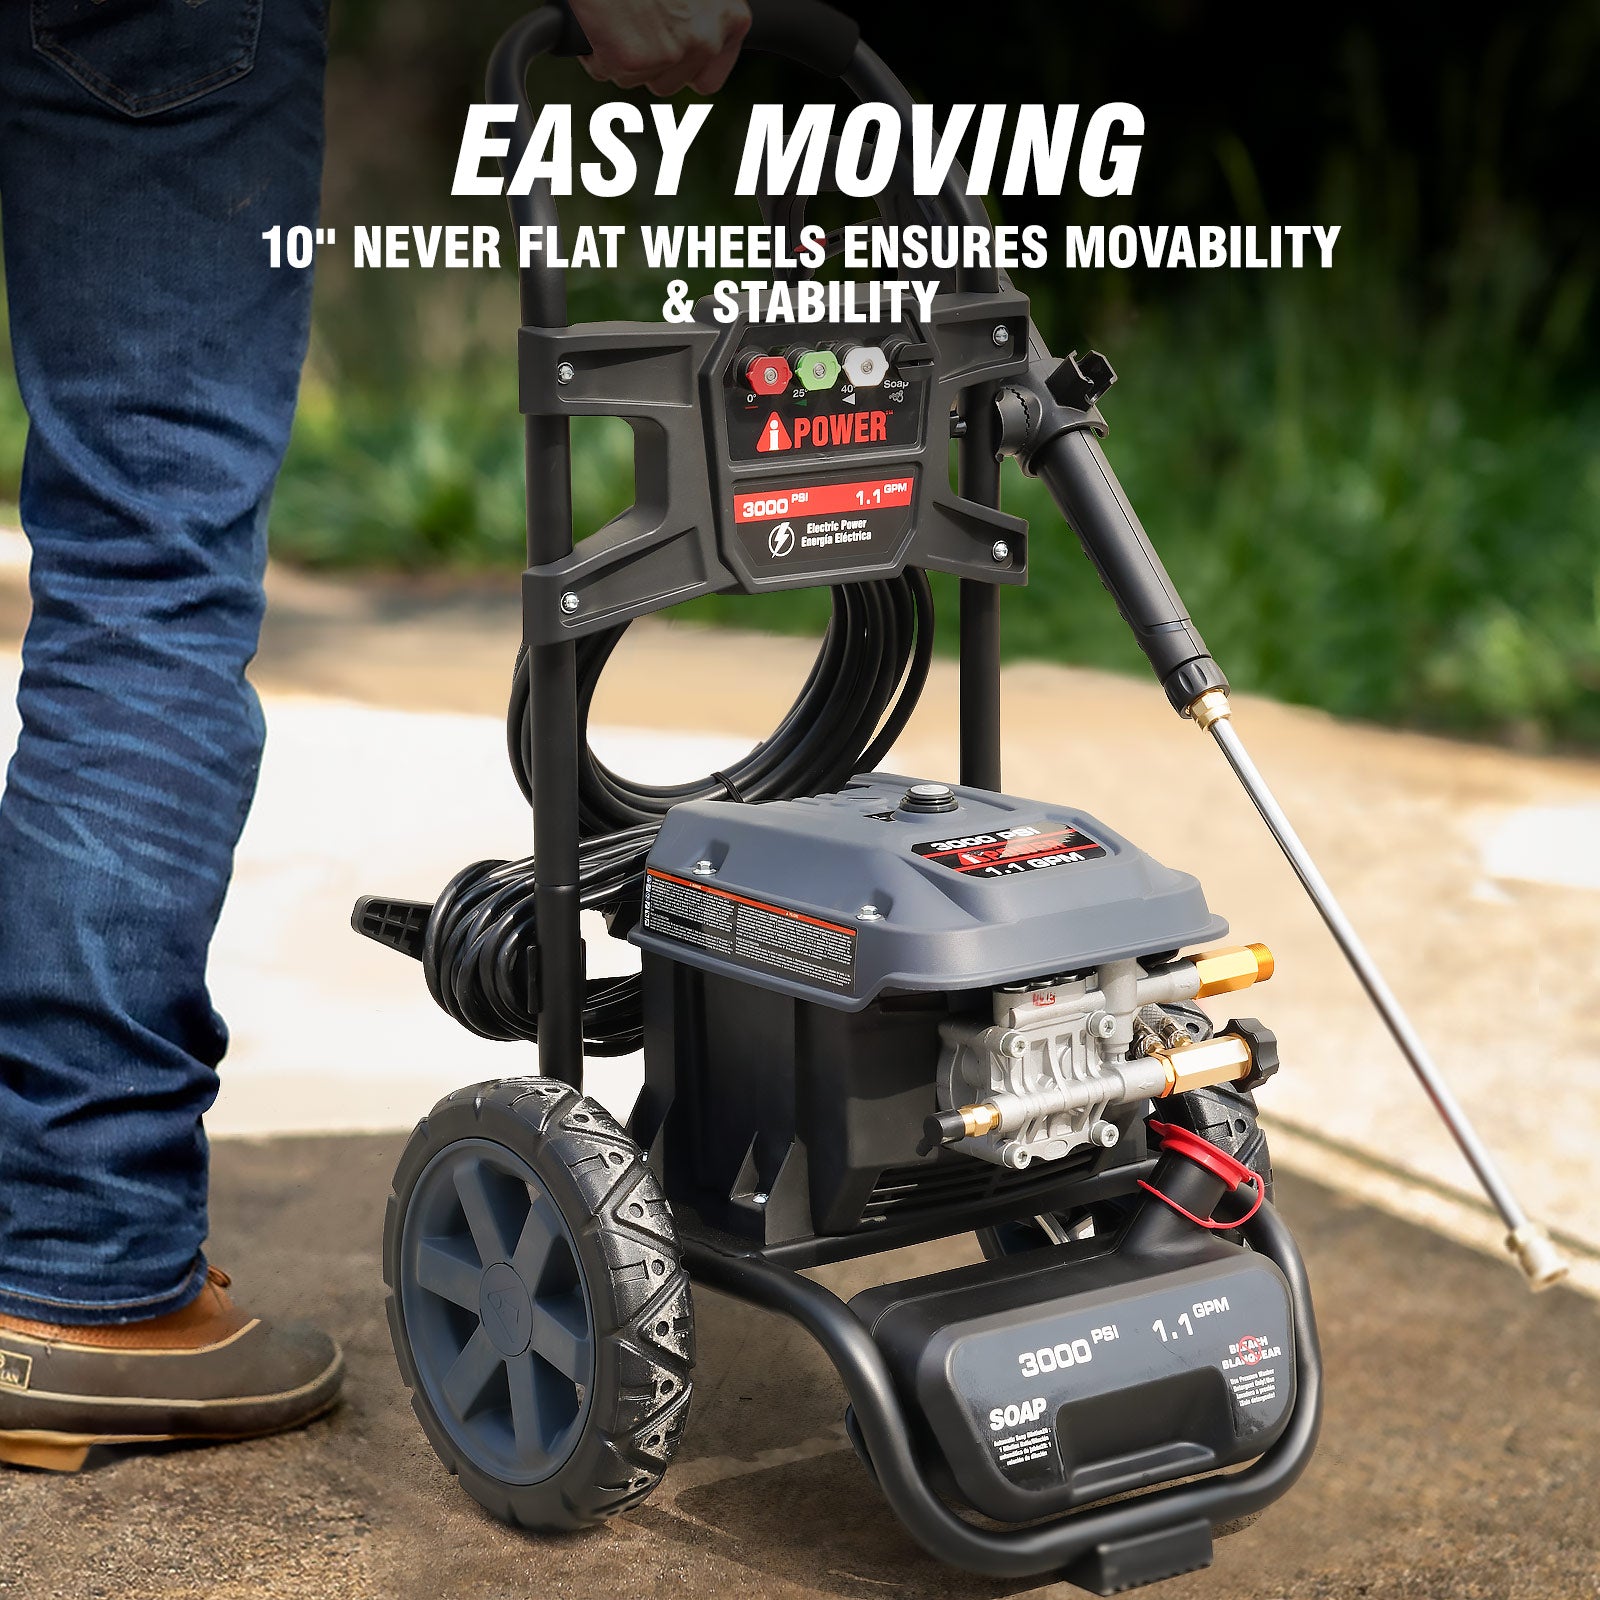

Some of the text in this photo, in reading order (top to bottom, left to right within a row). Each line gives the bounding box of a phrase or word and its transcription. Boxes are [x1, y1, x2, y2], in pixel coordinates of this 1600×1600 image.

[883, 379, 909, 389] Soap
[794, 410, 887, 449] POWER
[742, 498, 789, 518] 3000
[856, 488, 881, 506] 1.1
[883, 482, 908, 494] GPM
[807, 519, 868, 535] Electric Power
[930, 826, 1042, 852] 3000 PSI
[1027, 851, 1086, 869] GPM
[1018, 1296, 1230, 1378] 3000 PSI 1.1 GPM
[989, 1397, 1047, 1431] SOAP
